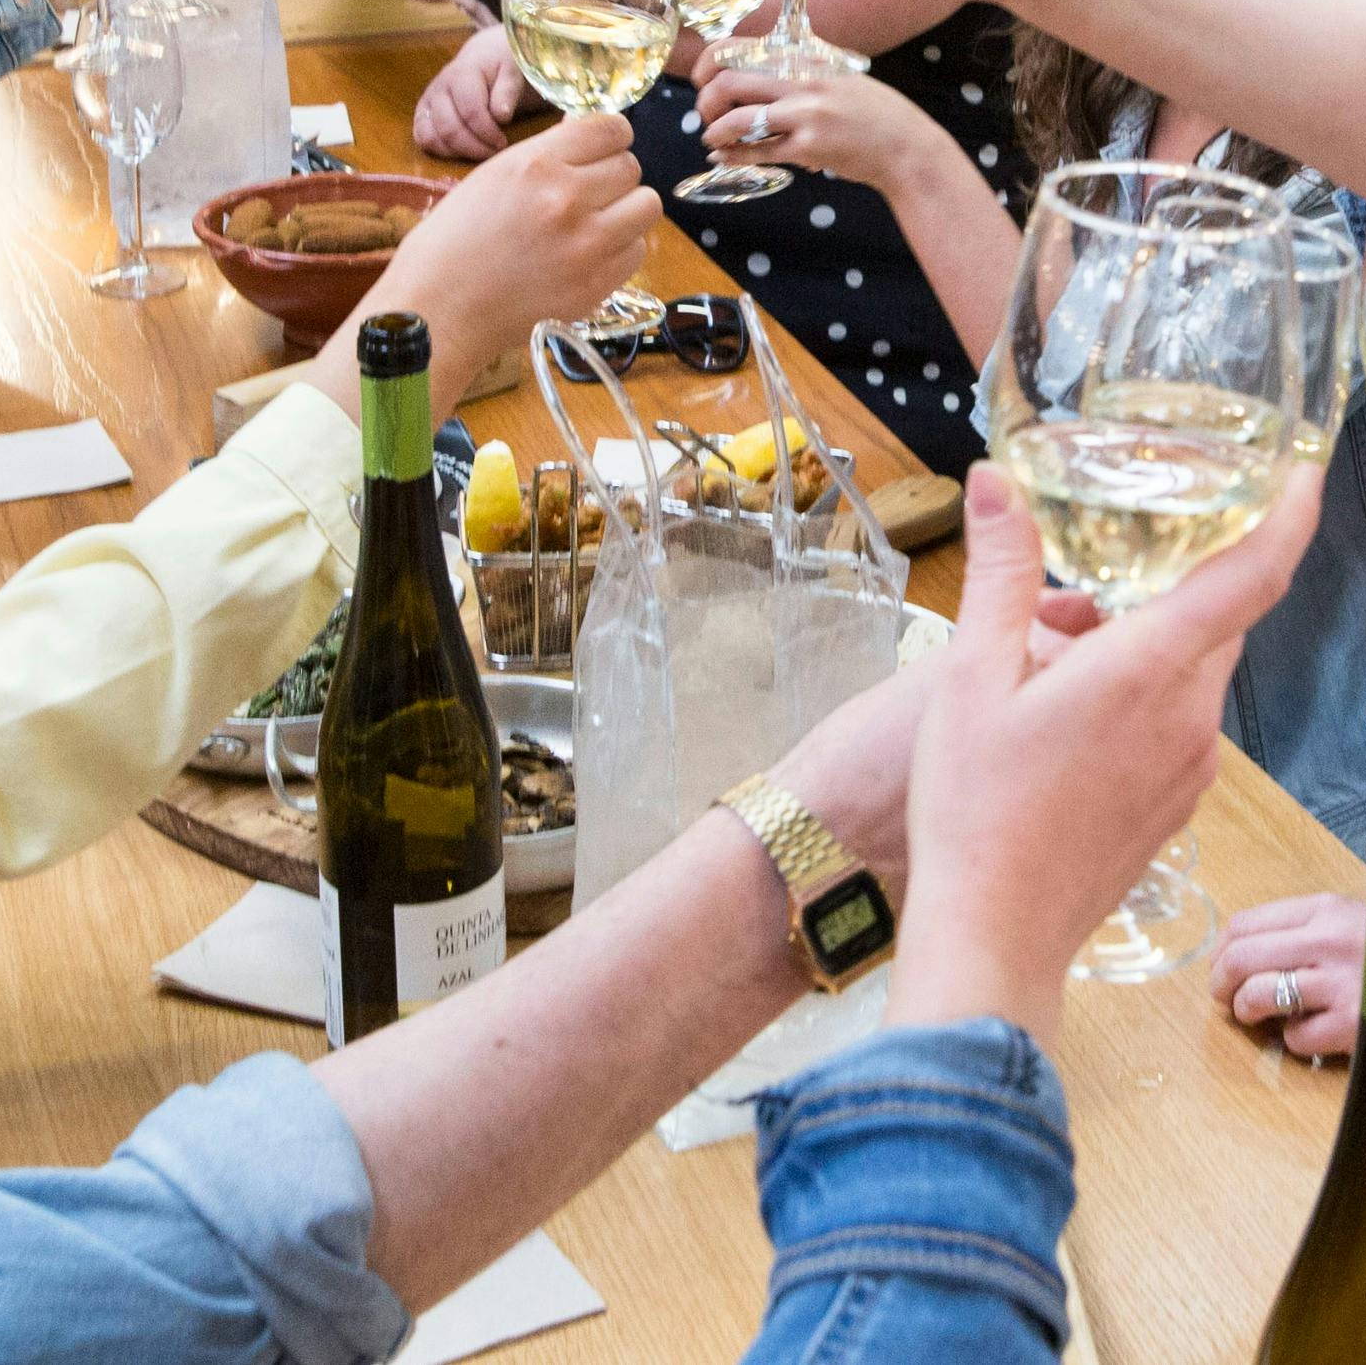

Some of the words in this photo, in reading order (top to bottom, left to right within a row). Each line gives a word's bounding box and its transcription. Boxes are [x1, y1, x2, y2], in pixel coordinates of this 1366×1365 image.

[436, 908, 491, 942] QUINTA
[437, 940, 458, 959] DE
[438, 968, 474, 988] AZAL
